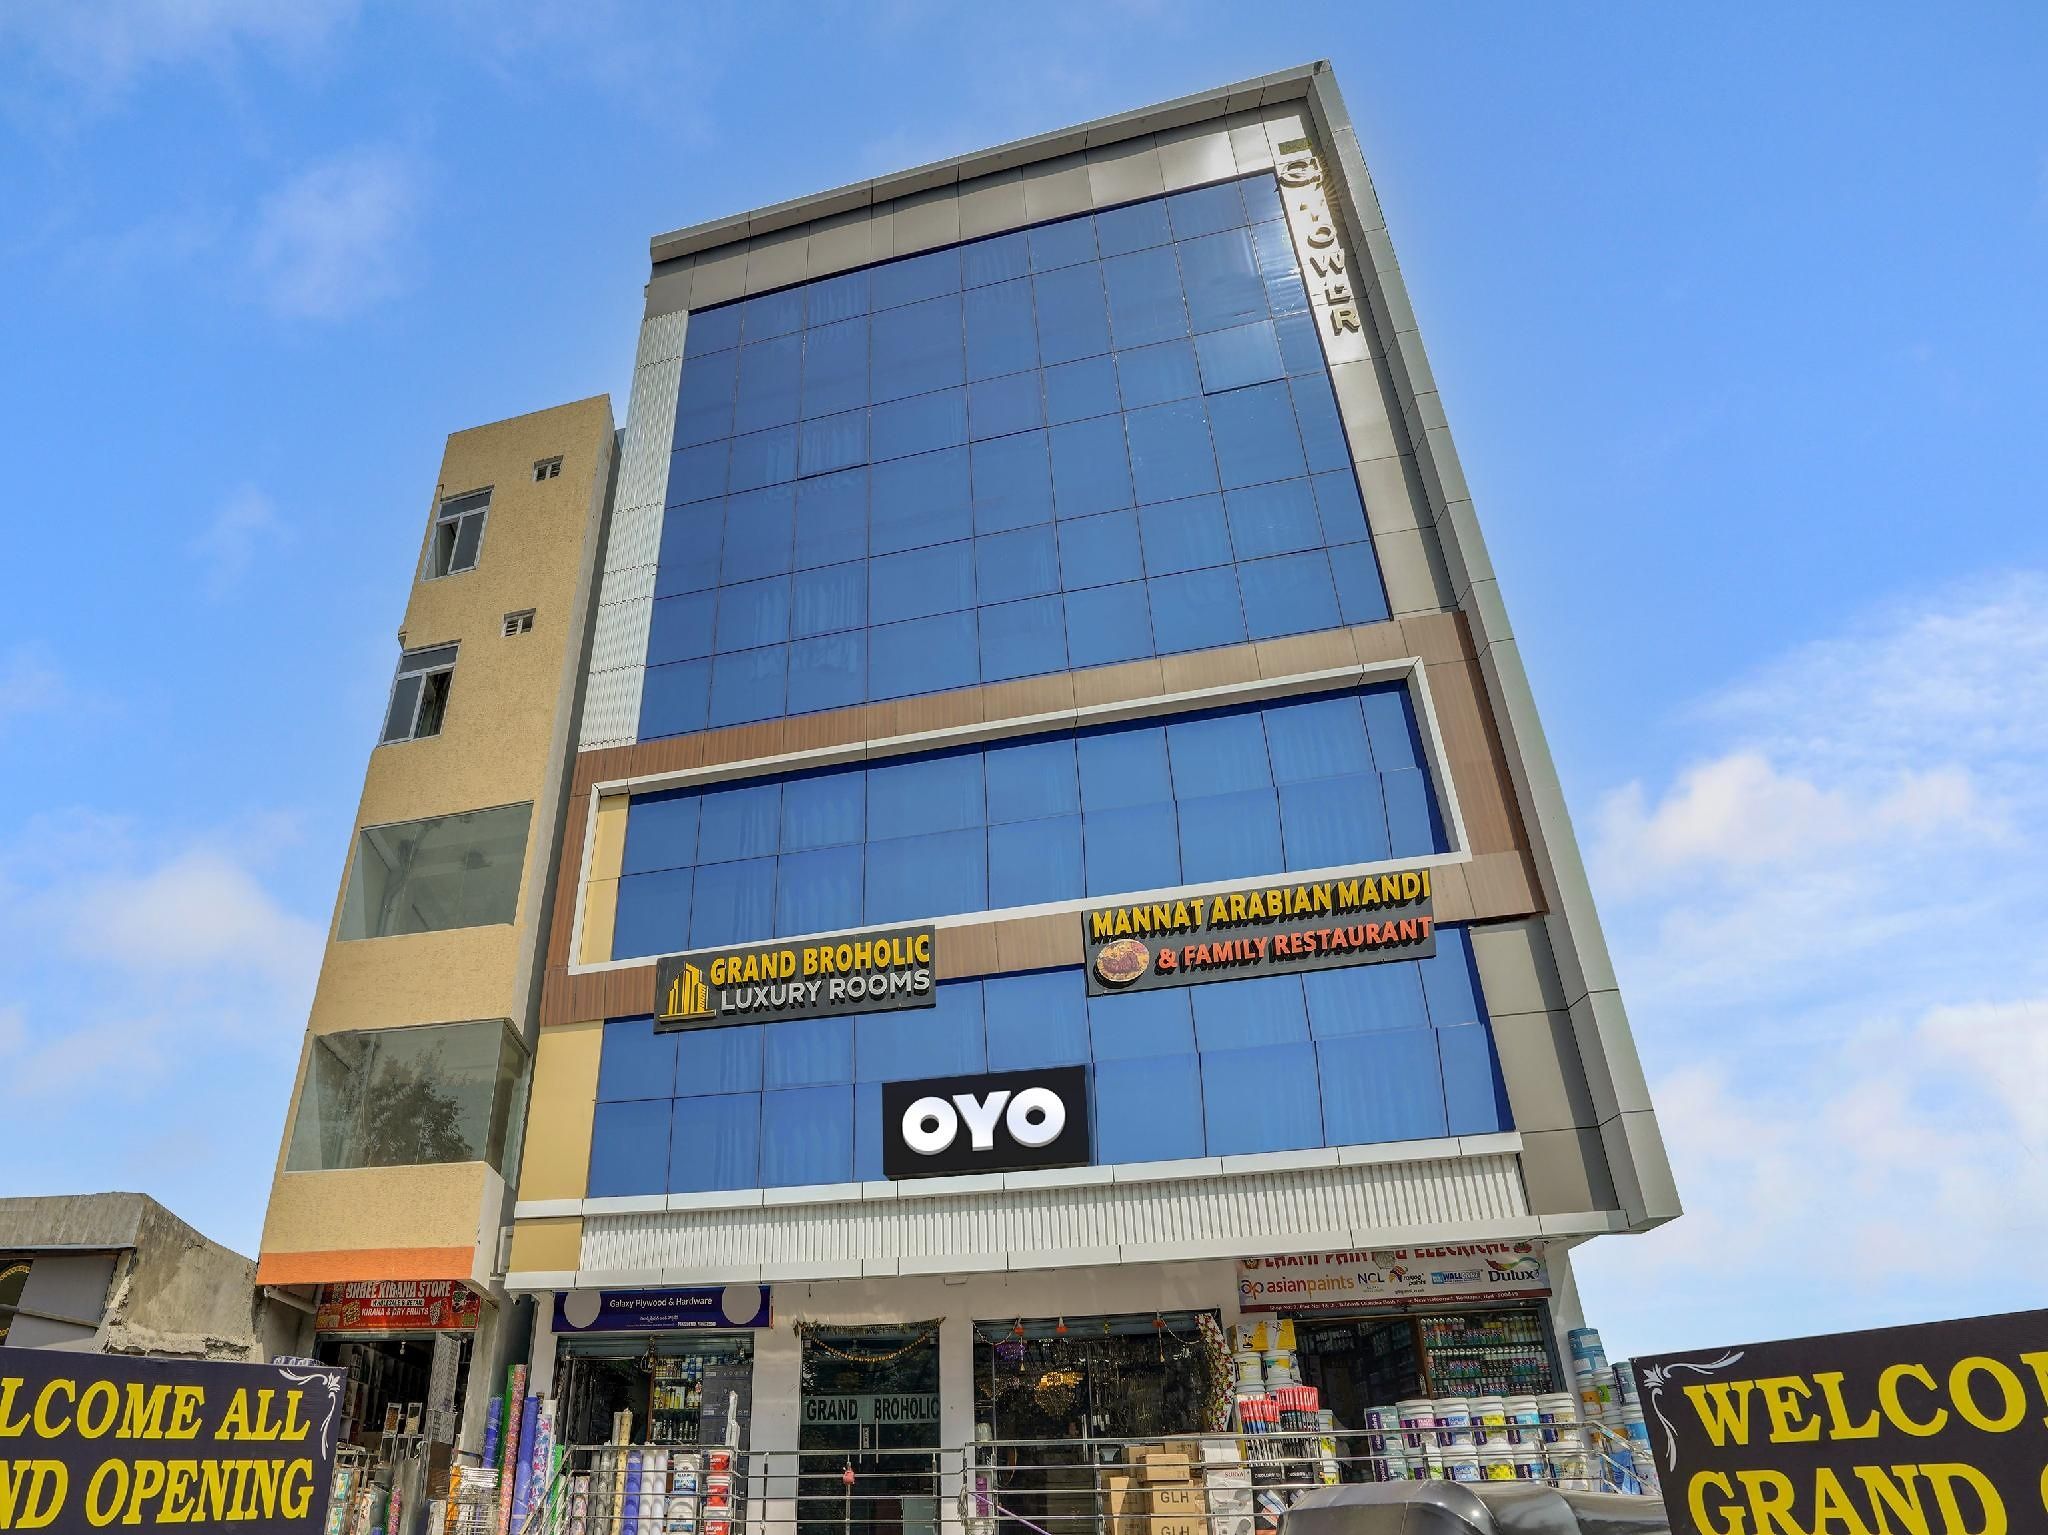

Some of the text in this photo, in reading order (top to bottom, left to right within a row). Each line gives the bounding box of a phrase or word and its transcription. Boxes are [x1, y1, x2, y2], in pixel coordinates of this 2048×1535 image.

[1092, 870, 1431, 938] MANNAT ARABIAN MANDI
[709, 934, 931, 987] GRAND BROHOLIC
[1157, 916, 1433, 969] & FAMILY RESTAURANT
[720, 969, 931, 1011] LUXURY ROOMS
[901, 1087, 1067, 1157] OYO
[418, 1281, 452, 1297] STORE
[1266, 1274, 1355, 1299] asianpaints
[1357, 1273, 1385, 1285] NCL
[1487, 1269, 1535, 1283] Dulux
[609, 1297, 713, 1309] Galaxy Plywood & Hardware
[214, 1388, 311, 1441] ALL
[806, 1397, 939, 1421] GRAND BROHOLIC
[85, 1458, 314, 1527] OPENING
[1160, 1491, 1189, 1503] GLH
[1688, 1463, 2008, 1535] GRAND
